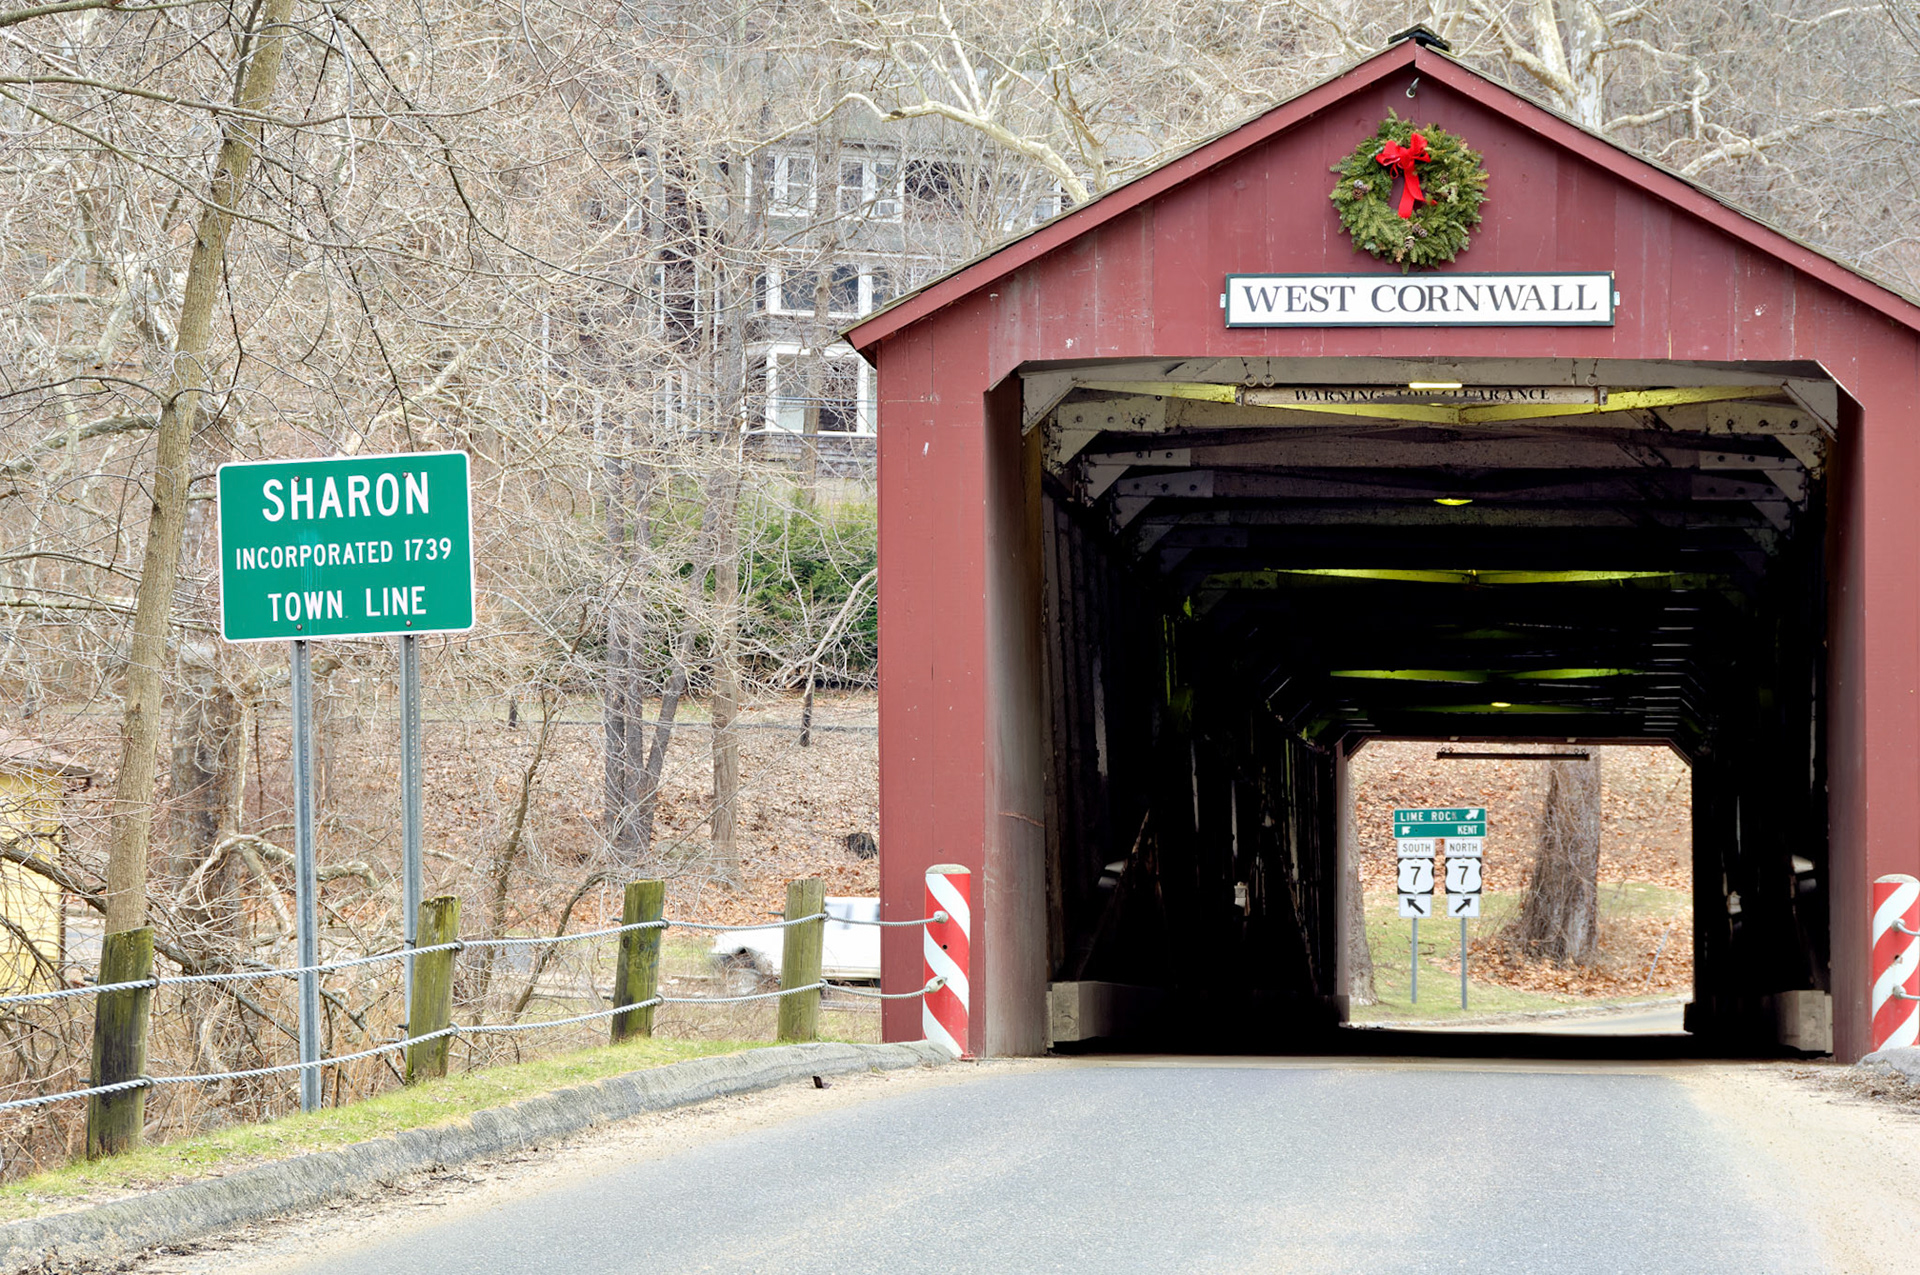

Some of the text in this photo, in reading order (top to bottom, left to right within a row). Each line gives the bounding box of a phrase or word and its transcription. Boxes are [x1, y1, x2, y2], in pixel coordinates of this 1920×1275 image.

[1241, 283, 1598, 313] WEST CORNWALL
[262, 472, 429, 522] SHARON
[236, 537, 451, 570] INCORPORATED 1739
[268, 586, 426, 621] TOWN LINE
[1400, 811, 1458, 821] LIME ROCK
[1457, 825, 1478, 835] KENT
[1402, 843, 1431, 852] SOUTH
[1449, 842, 1478, 852] NORTH
[1410, 866, 1421, 885] 7
[1458, 865, 1469, 885] 7
